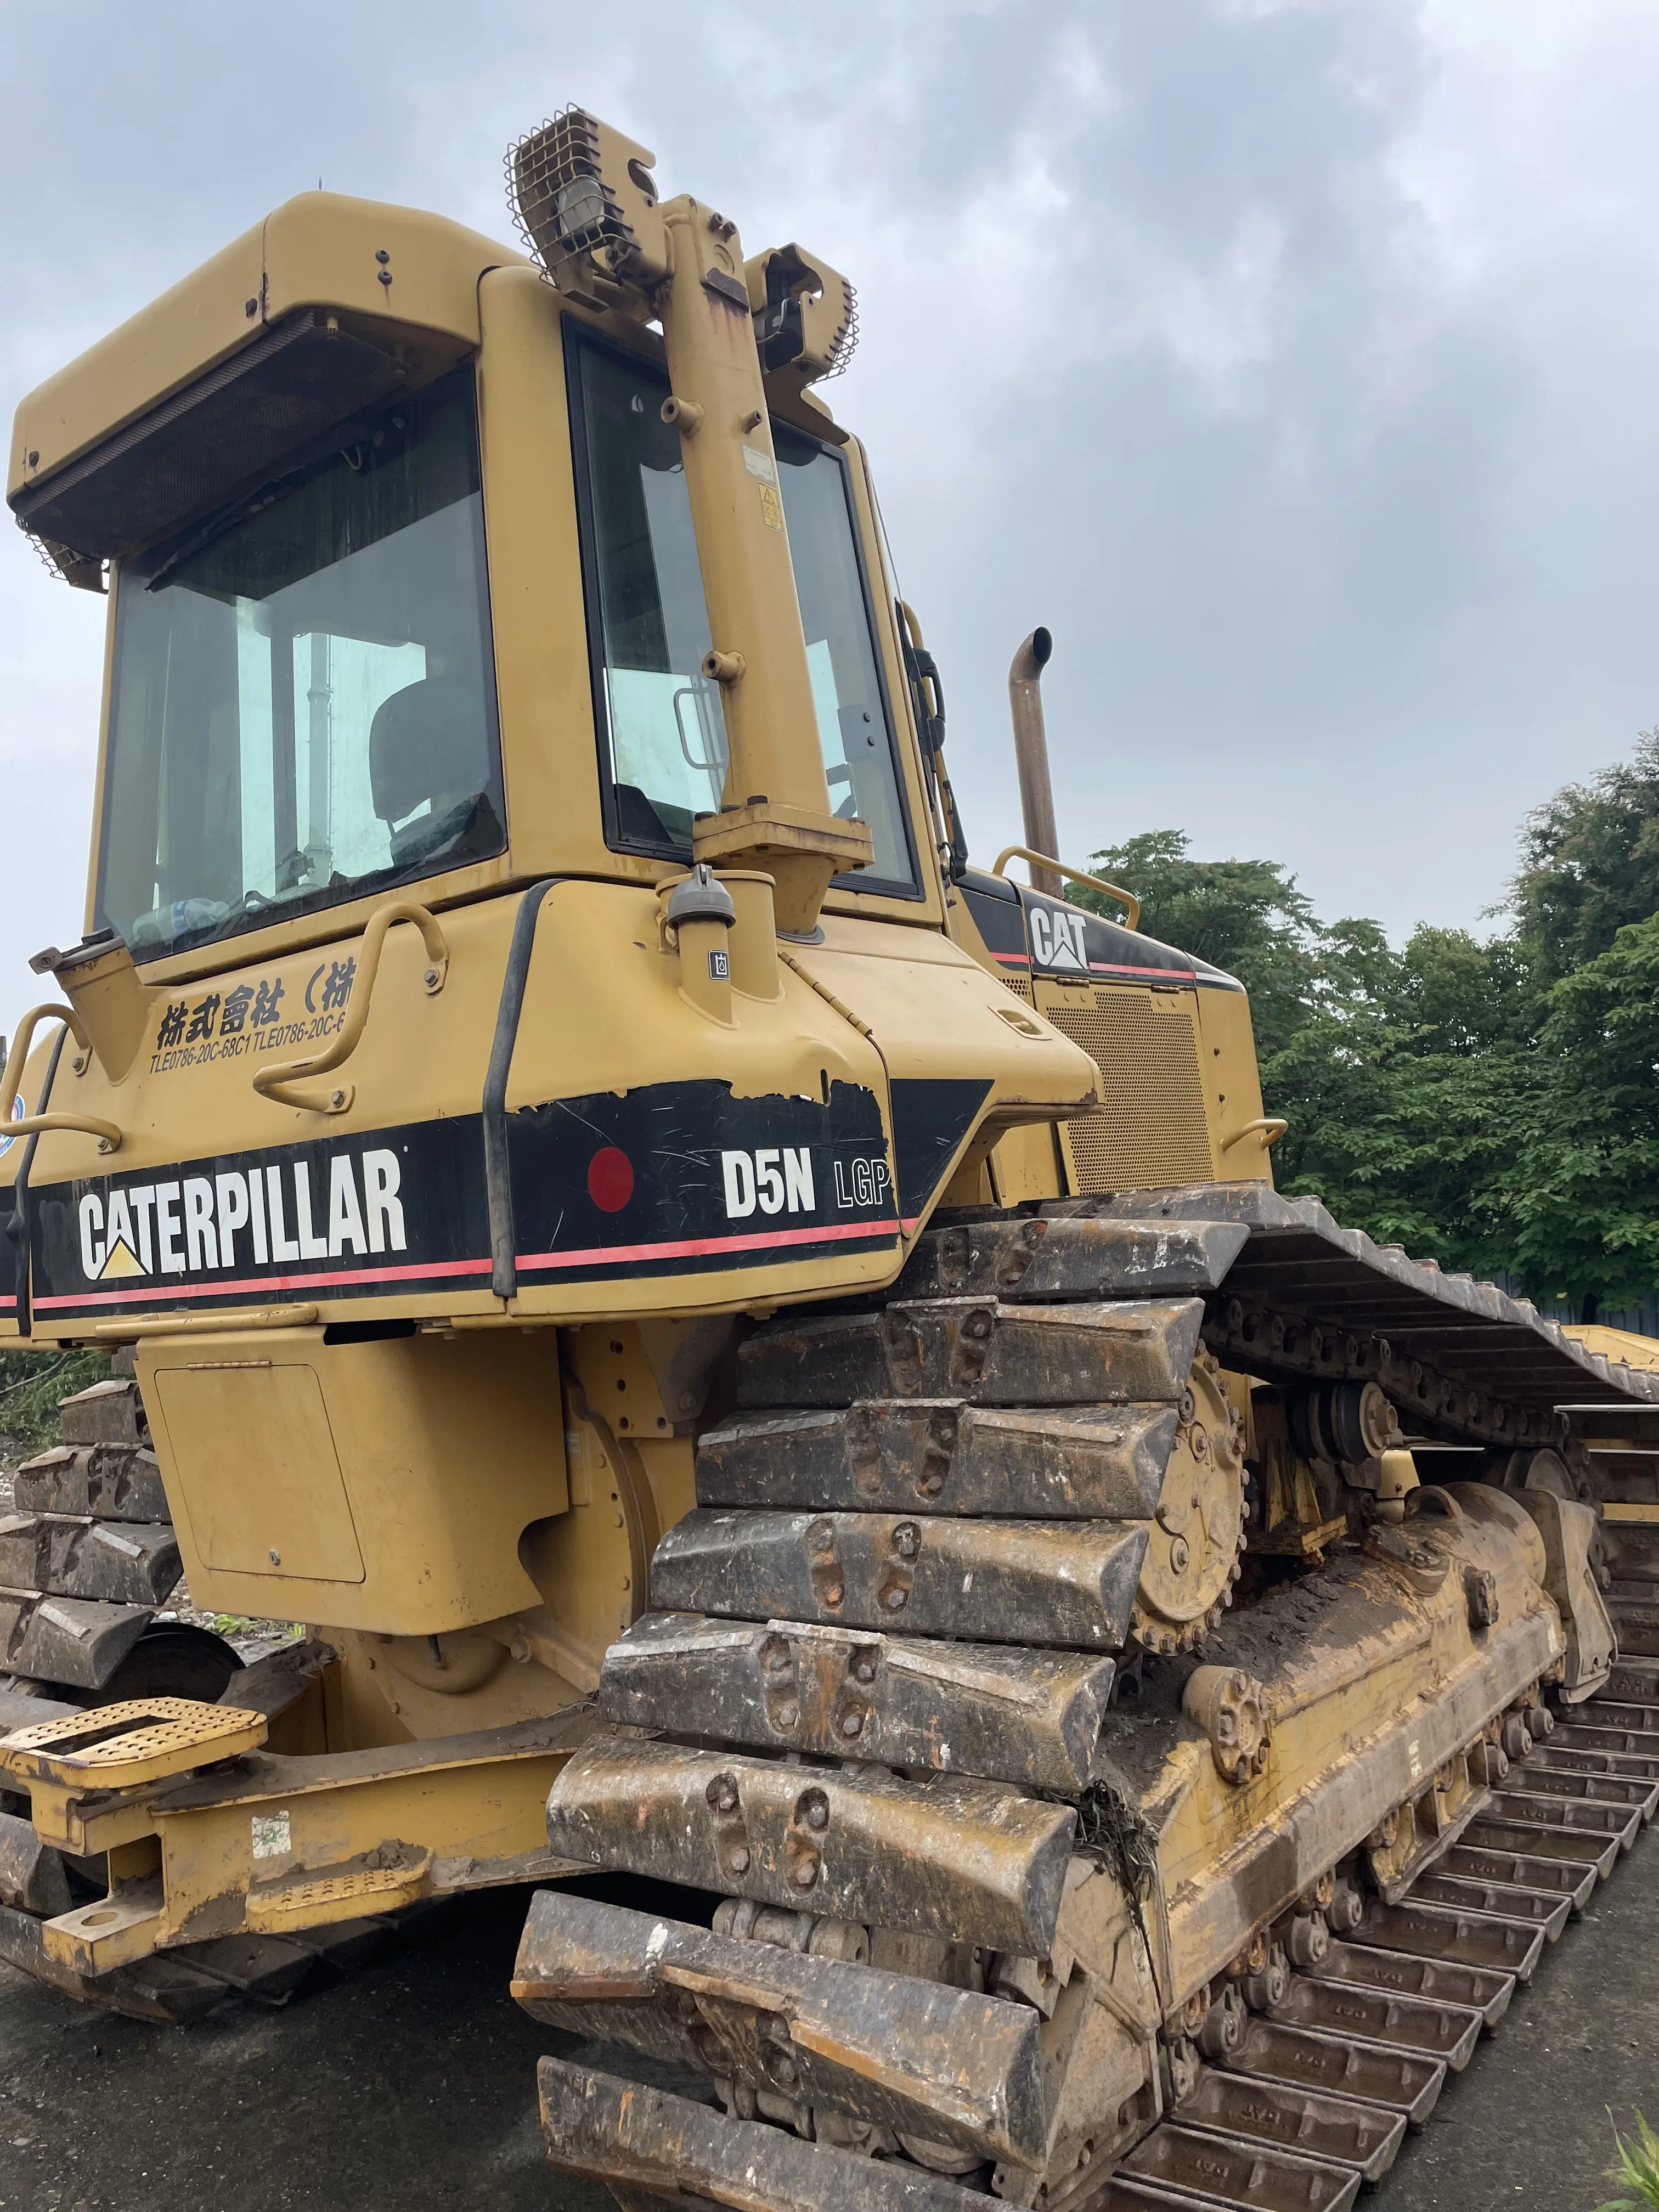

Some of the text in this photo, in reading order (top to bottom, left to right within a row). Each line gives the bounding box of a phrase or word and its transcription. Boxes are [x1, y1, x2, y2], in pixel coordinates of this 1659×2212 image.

[1030, 907, 1087, 969] CAT
[150, 1034, 251, 1074] TLE0786-20C-68C1
[79, 1149, 408, 1280] CATERPILLAR
[721, 1147, 891, 1218] D5N LGP
